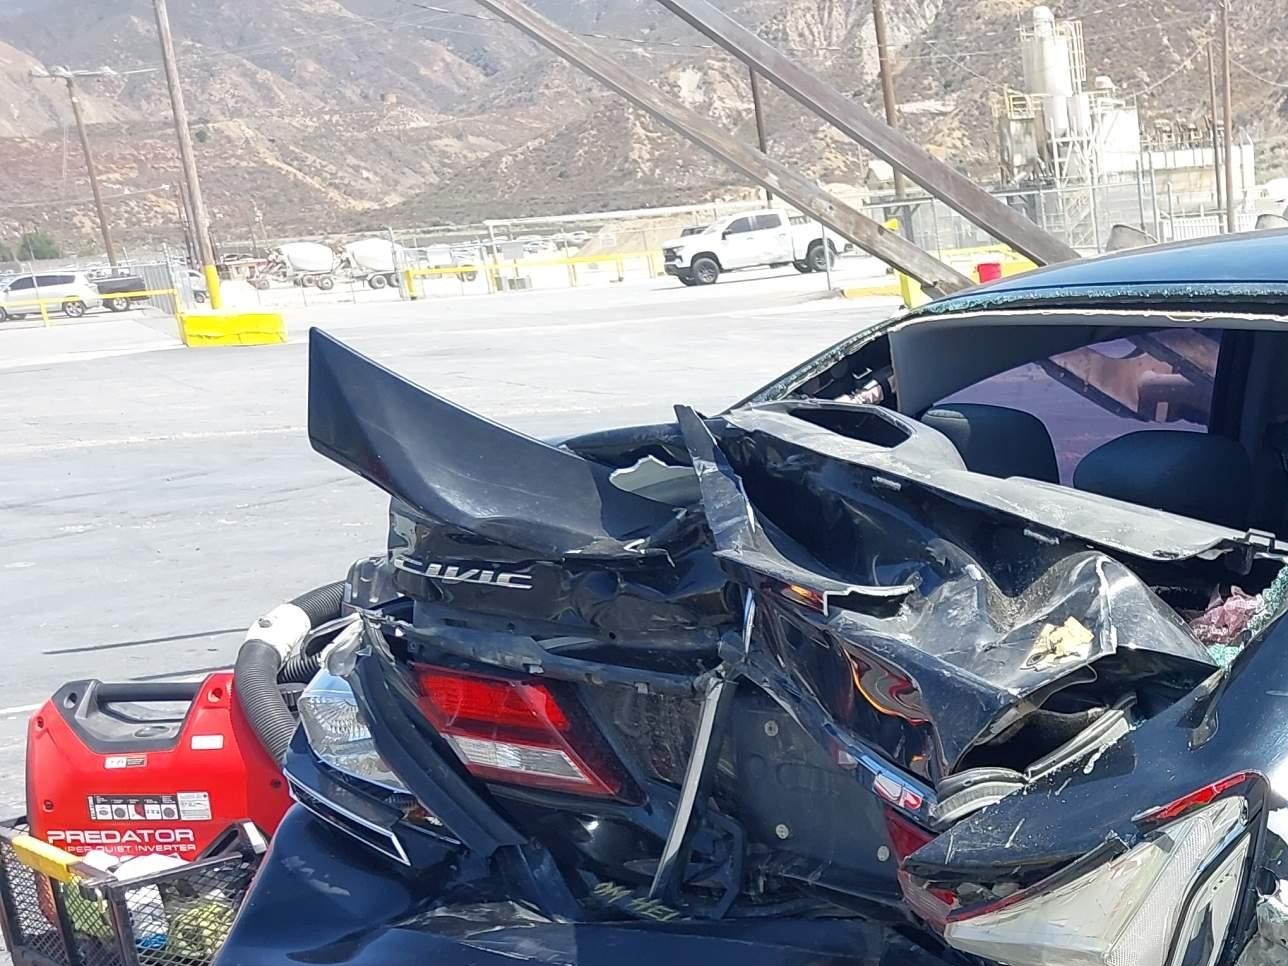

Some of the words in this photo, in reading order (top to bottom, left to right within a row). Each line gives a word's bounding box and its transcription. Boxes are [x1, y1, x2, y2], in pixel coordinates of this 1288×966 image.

[394, 554, 533, 589] CIVIC
[47, 829, 194, 844] PREDATOR
[135, 843, 196, 852] INVERTER
